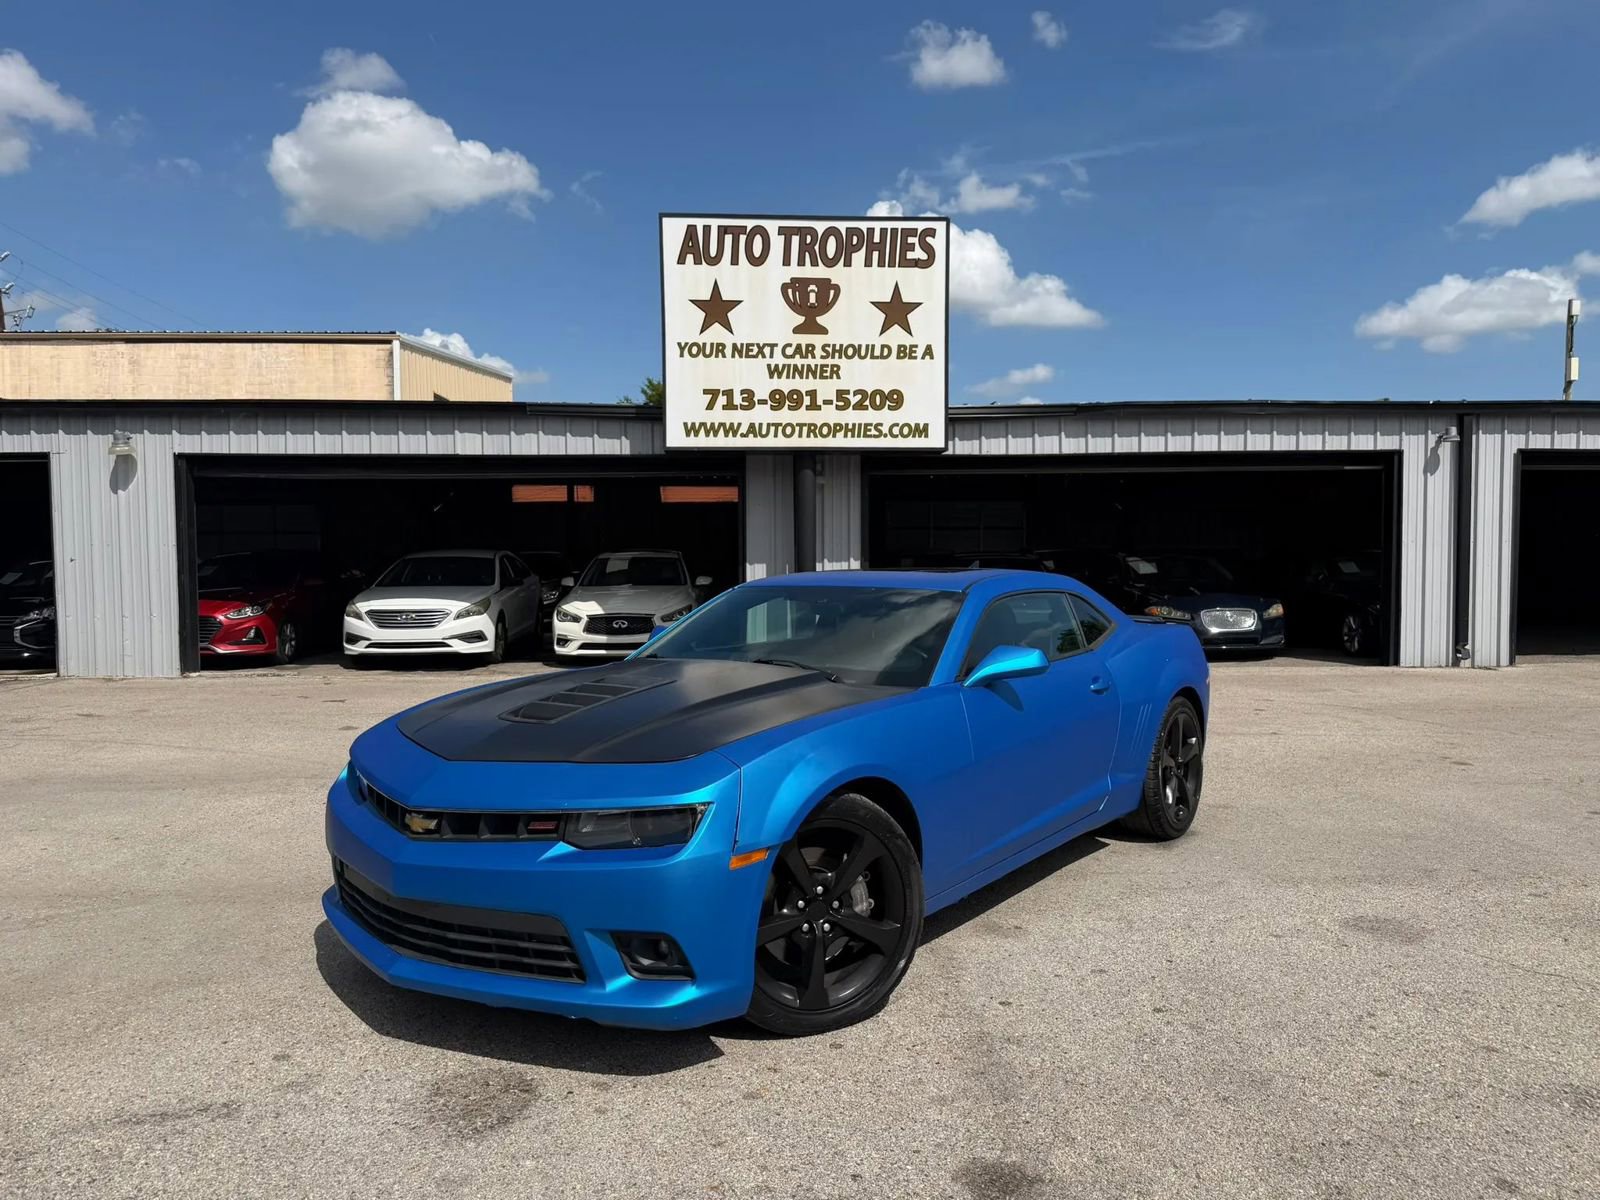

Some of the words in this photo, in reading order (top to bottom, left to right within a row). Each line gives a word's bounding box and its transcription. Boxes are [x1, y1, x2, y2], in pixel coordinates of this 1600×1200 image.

[677, 224, 771, 267] AUTO
[777, 226, 937, 270] TROPHIES
[677, 342, 727, 359] YOUR
[731, 343, 778, 360] NEXT
[781, 343, 817, 360] CAR
[820, 344, 892, 360] SHOULD
[896, 344, 919, 360] BE
[921, 344, 935, 360] A
[766, 363, 841, 380] WINNER
[702, 388, 905, 411] 713-991-5209
[683, 421, 929, 439] WWW.AUTOTROPHIES.COM
